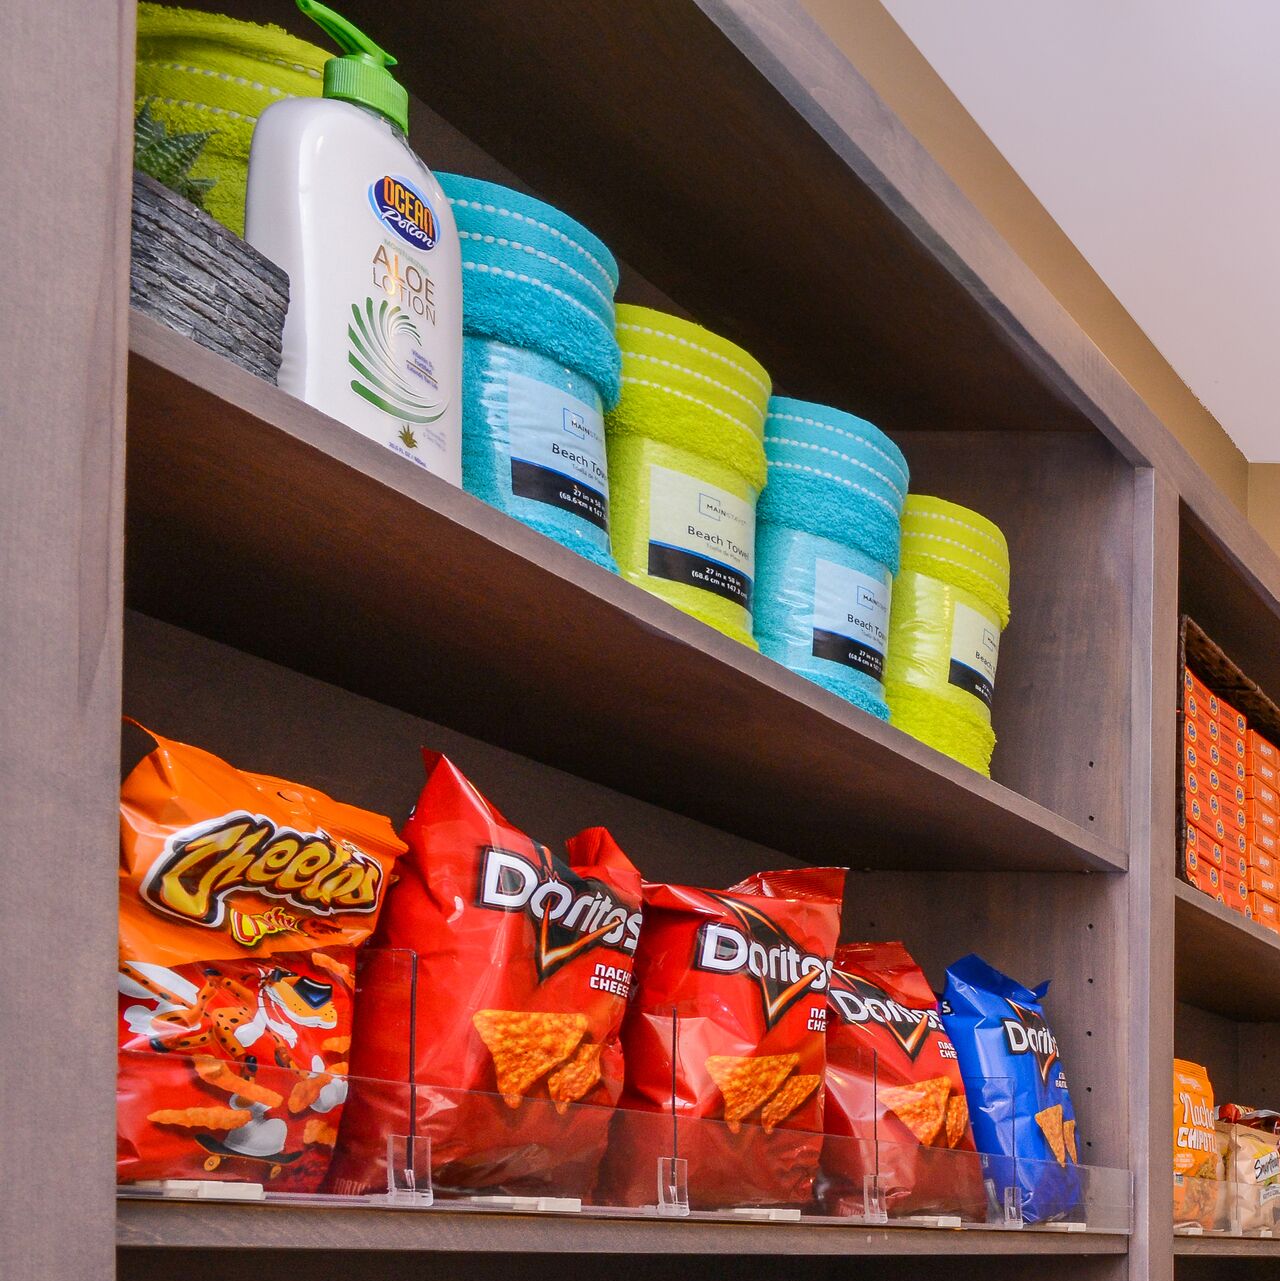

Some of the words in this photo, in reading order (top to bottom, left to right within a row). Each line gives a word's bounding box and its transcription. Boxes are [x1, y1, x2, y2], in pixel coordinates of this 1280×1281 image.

[384, 176, 433, 237] OCEAN
[381, 206, 435, 248] Potion
[373, 245, 434, 306] ALOE
[373, 267, 436, 326] LOTION
[552, 443, 588, 467] Beach
[573, 489, 581, 497] 27
[687, 525, 724, 547] Beach
[691, 569, 709, 581] (68.6
[710, 577, 720, 586] cm
[705, 567, 713, 575] 27
[715, 570, 722, 578] in
[847, 613, 873, 632] Beach
[158, 818, 382, 923] Cheetos
[484, 852, 643, 951] Doritos
[1180, 1092, 1214, 1129] Nacho
